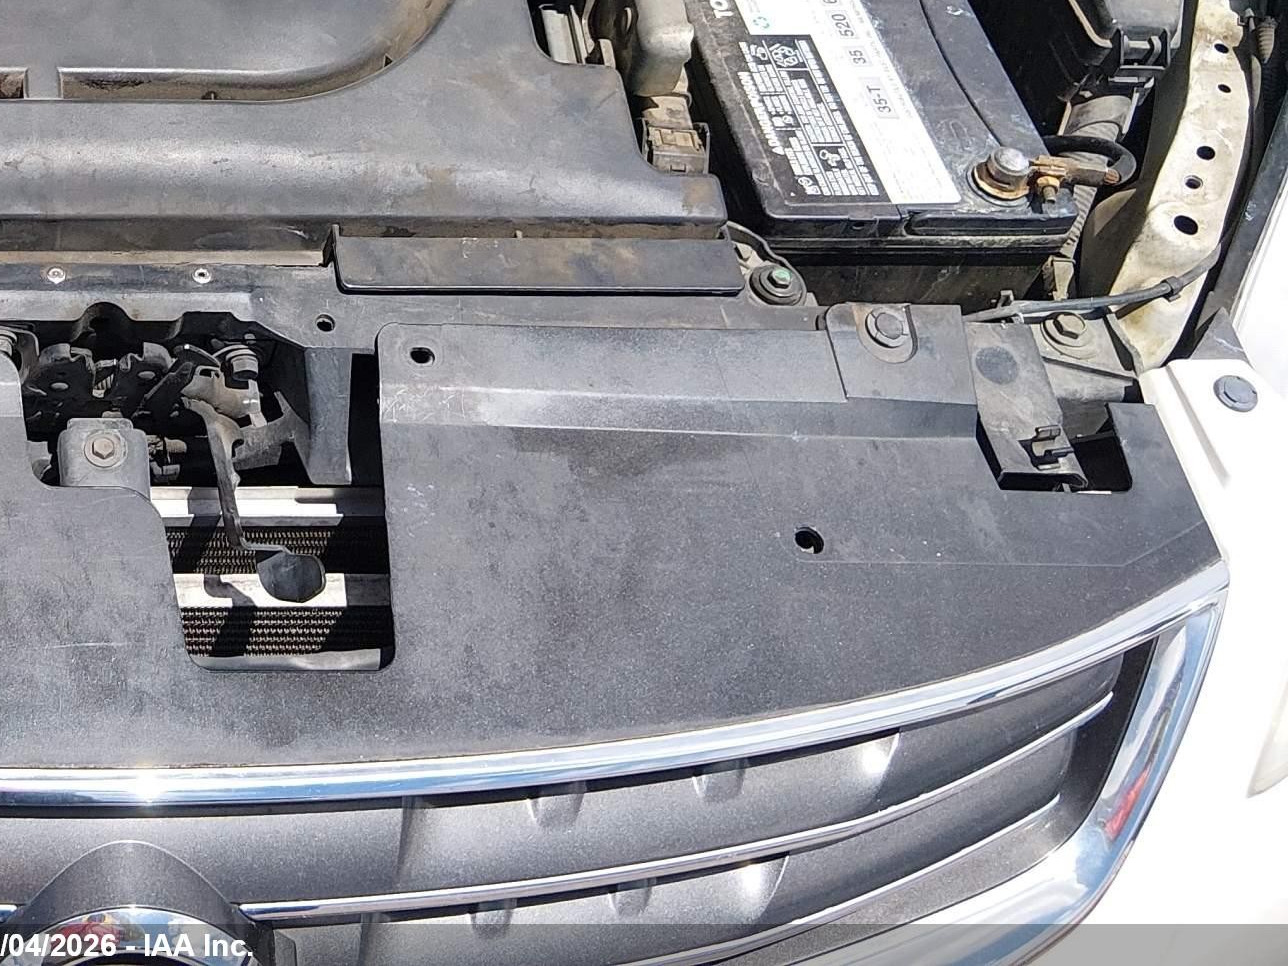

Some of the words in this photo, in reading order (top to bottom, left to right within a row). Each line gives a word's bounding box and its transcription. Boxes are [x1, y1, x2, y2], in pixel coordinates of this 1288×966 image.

[831, 13, 856, 39] 520
[852, 49, 867, 66] 35
[866, 85, 892, 113] 35-T
